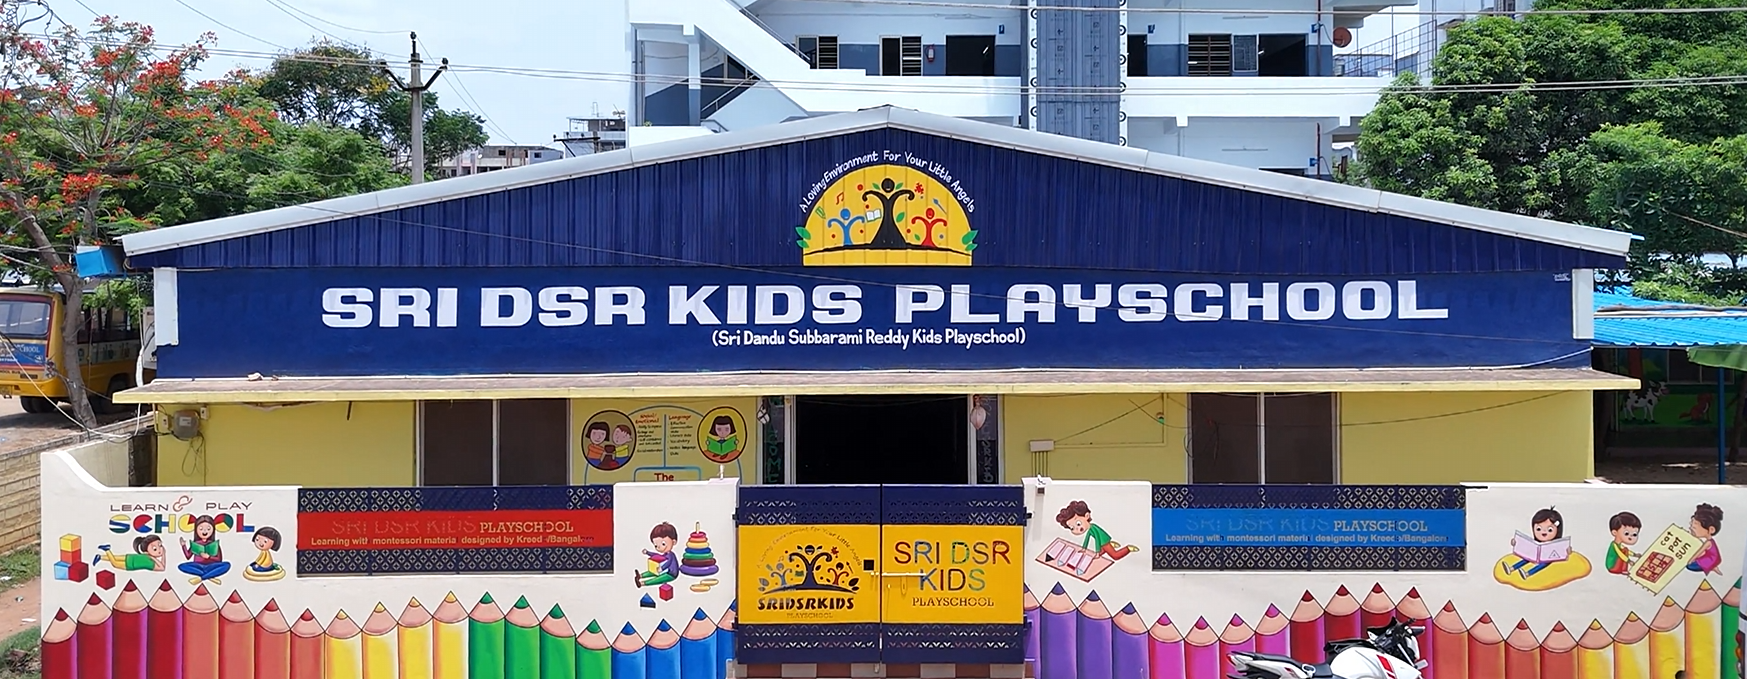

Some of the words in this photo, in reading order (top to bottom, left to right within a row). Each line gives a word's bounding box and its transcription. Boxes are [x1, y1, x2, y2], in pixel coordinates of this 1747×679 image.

[799, 203, 808, 213] A
[805, 178, 827, 205] Loving
[823, 151, 879, 183] Environment
[883, 150, 901, 161] For
[904, 151, 928, 168] Your
[928, 161, 952, 183] Little
[950, 181, 975, 213] Angels
[321, 287, 458, 328] SRI
[480, 287, 646, 328] DSR
[668, 284, 863, 326] KIDS
[895, 280, 1449, 323] PLAYSCHOOL
[712, 329, 741, 347] (Sri
[743, 329, 785, 345] Dandu
[788, 328, 863, 345] Subbarami
[865, 328, 910, 350] Reddy
[912, 328, 943, 344] Kids
[945, 326, 1026, 350] Playschool)
[653, 472, 674, 481] The
[110, 504, 169, 512] LEARN
[205, 502, 253, 510] PLAY
[109, 513, 255, 534] SCHOOL
[480, 521, 574, 533] PLAYSCHOOL
[1333, 520, 1428, 532] PLAYSCHOOL
[311, 537, 350, 547] Learning
[372, 537, 422, 545] montessori
[424, 537, 460, 545] materia
[461, 535, 502, 545] designed
[503, 535, 514, 545] by
[1165, 534, 1204, 543] Learning
[1227, 534, 1276, 542] montessori
[1315, 534, 1355, 543] designed
[1357, 534, 1368, 544] by
[1660, 531, 1673, 546] cat
[894, 541, 940, 564] SRI
[951, 540, 1011, 564] DSR
[919, 568, 986, 591] KIDS
[912, 597, 994, 606] PLAYSCHOOL
